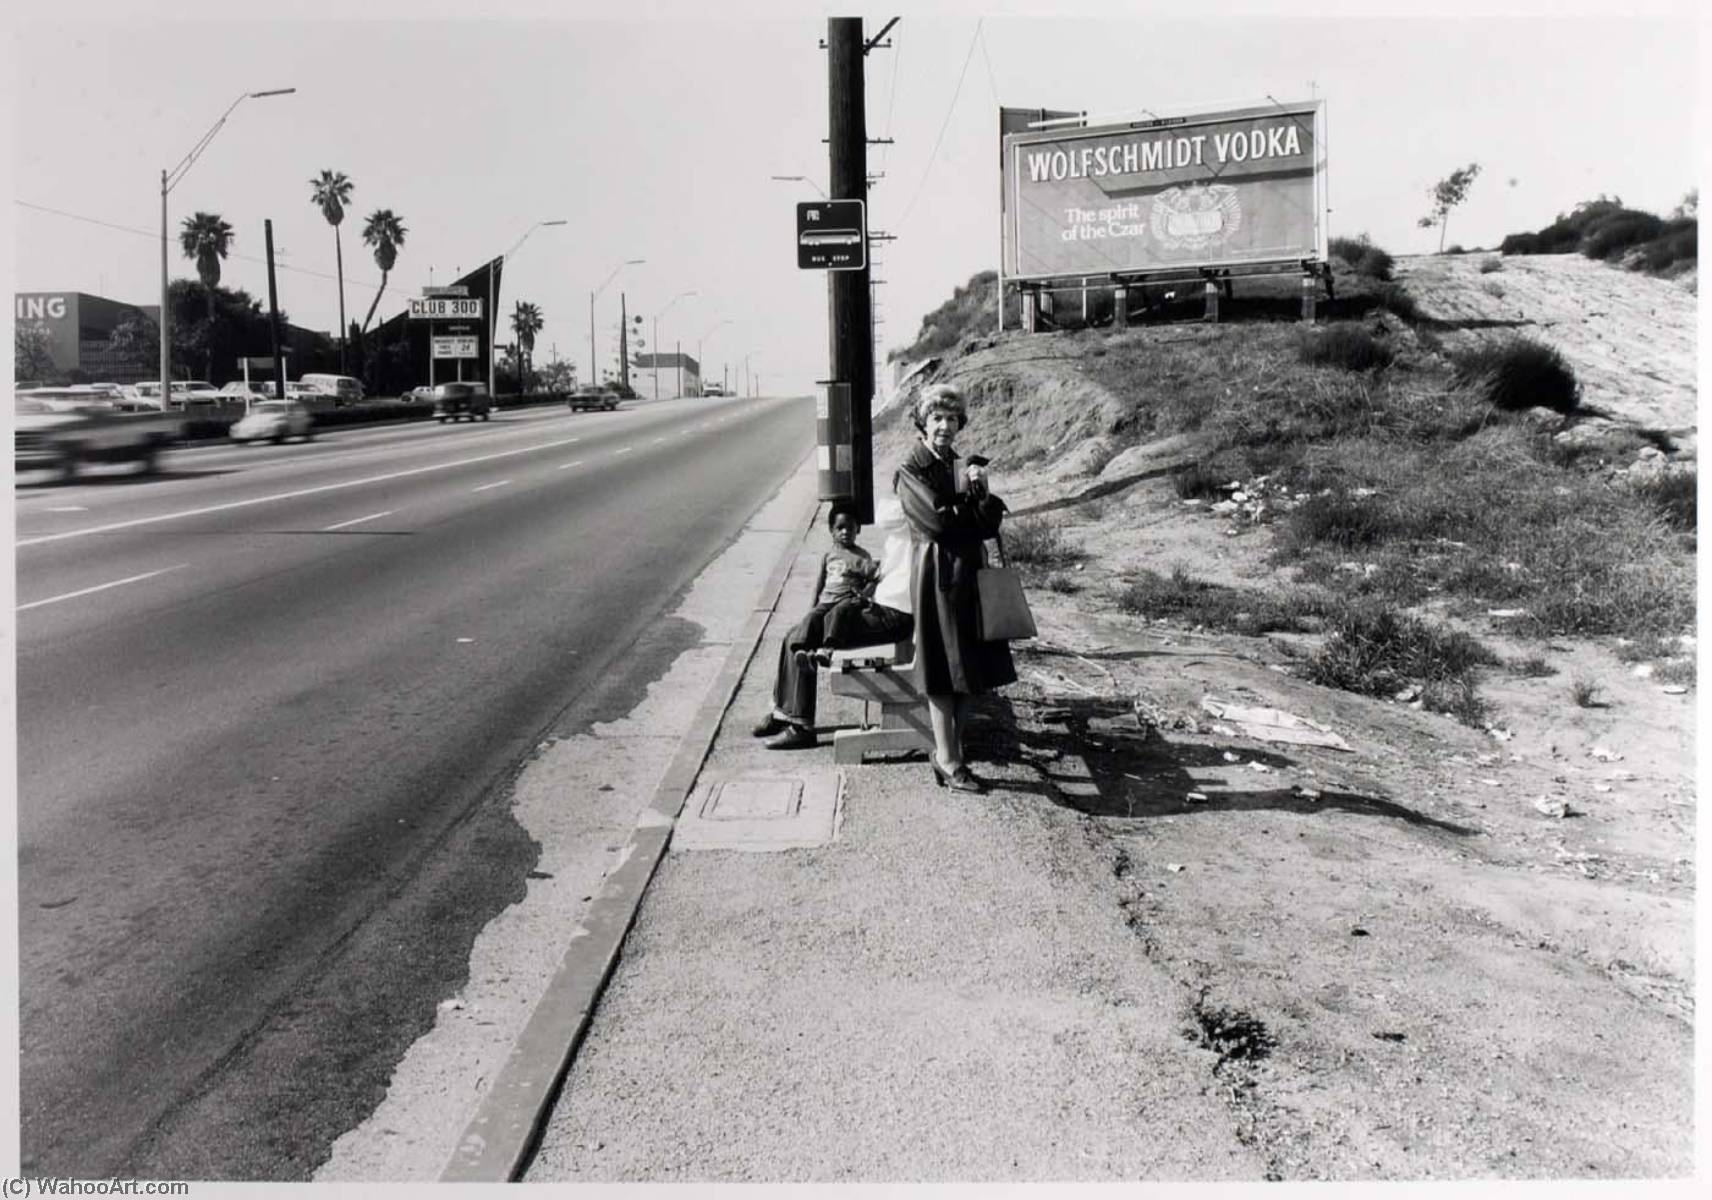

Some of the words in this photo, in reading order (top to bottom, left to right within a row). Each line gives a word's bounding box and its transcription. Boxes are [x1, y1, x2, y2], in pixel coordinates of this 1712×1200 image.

[1028, 136, 1205, 181] WOLFSCHMIDT
[1214, 126, 1301, 163] VODKA
[1064, 207, 1096, 223] The
[1100, 203, 1140, 223] spirit
[1062, 225, 1079, 241] of
[1080, 223, 1106, 239] the
[1108, 221, 1146, 238] Czar
[17, 297, 66, 319] ING
[412, 301, 445, 313] CLUB
[452, 301, 476, 313] 300
